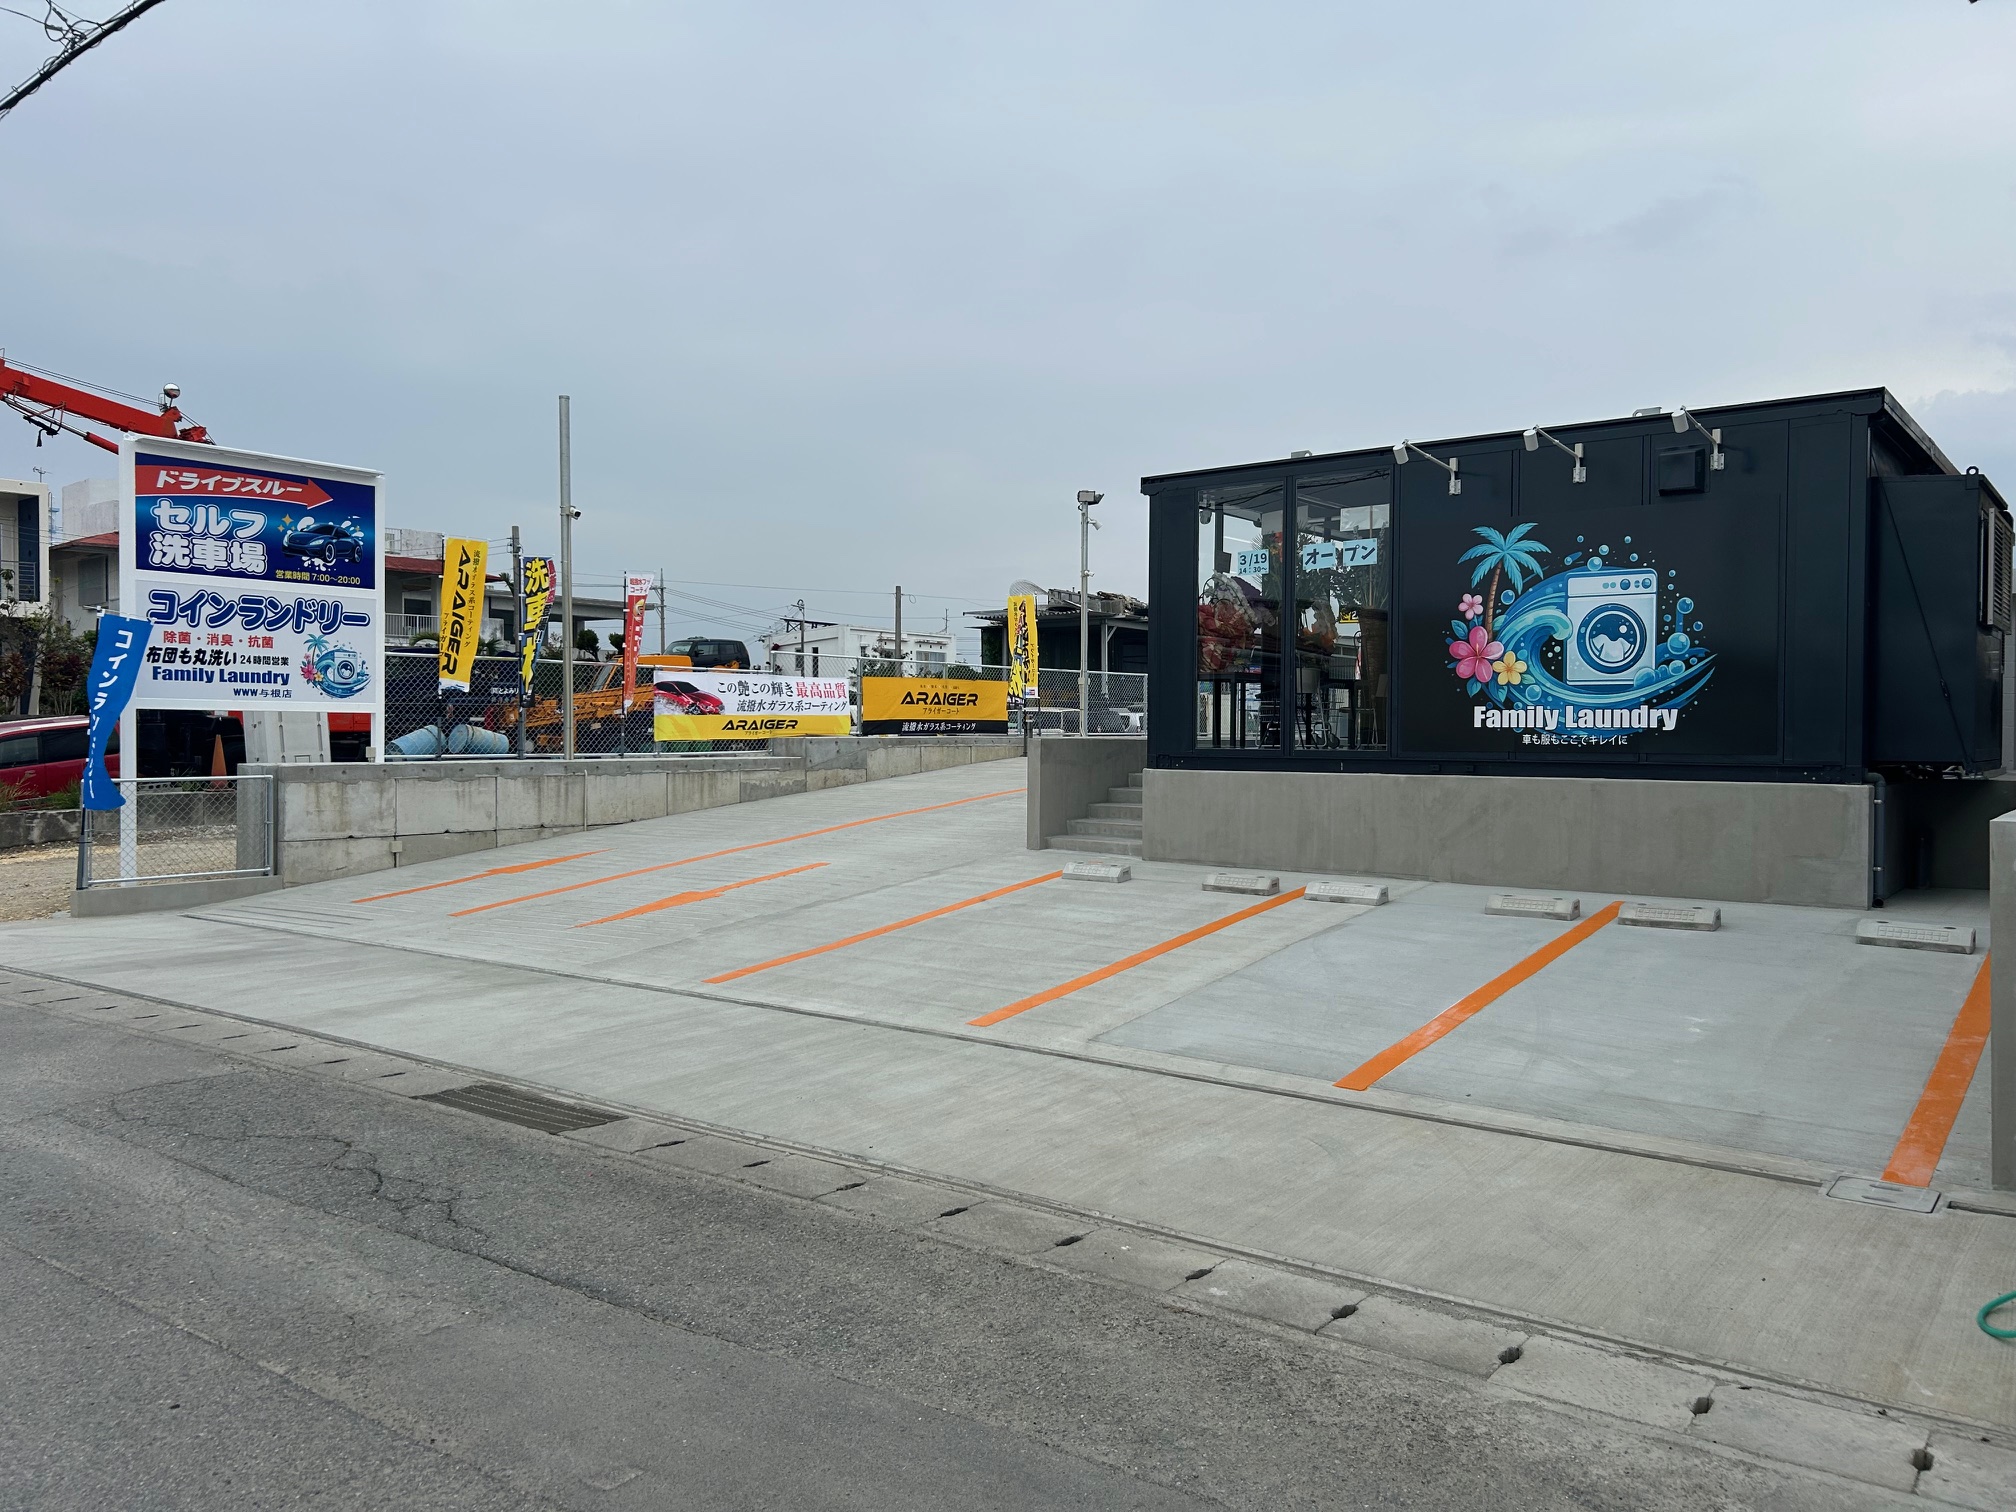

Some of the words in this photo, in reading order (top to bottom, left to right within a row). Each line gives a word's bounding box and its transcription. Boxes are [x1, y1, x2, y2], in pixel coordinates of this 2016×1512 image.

[156, 470, 304, 496] ドライブスルー
[151, 498, 267, 537] セルフ
[149, 533, 267, 574] 洗車場
[1239, 553, 1267, 567] 3/19
[275, 569, 310, 581] 営業時間
[147, 589, 371, 634] コインランドリー
[442, 545, 472, 676] ARAIGER
[146, 645, 237, 667] 布団も丸洗い
[240, 654, 289, 666] 24時間営業
[152, 666, 215, 685] Family
[219, 668, 290, 687] Laundry
[736, 699, 847, 713] 流撥水ガラス系コーティング
[901, 691, 979, 706] ARAIGER
[722, 719, 798, 731] ARAIGER
[1473, 705, 1560, 730] Family
[1565, 705, 1678, 731] Laundry
[1522, 734, 1629, 746] 車も服もここでキレイに
